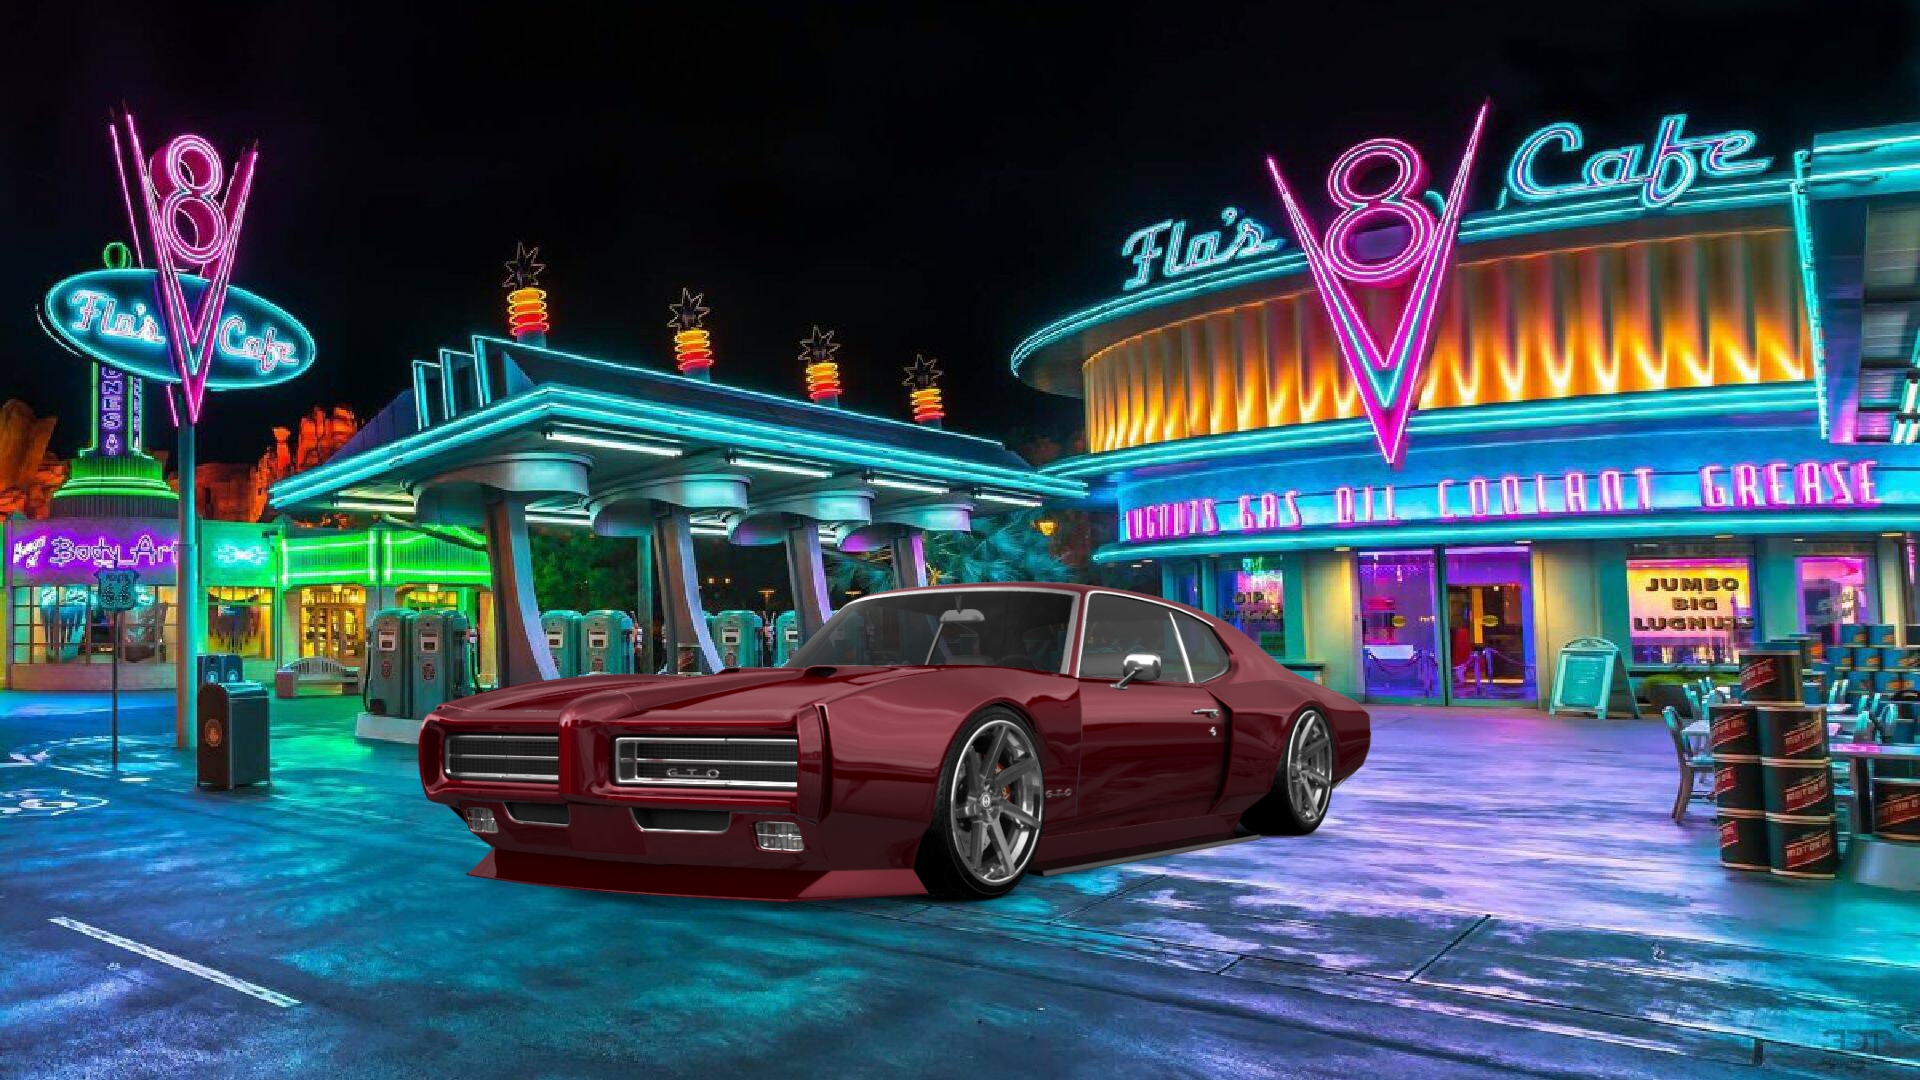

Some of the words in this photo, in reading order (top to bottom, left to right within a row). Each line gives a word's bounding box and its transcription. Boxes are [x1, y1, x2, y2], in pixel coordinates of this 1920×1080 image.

[1122, 206, 1287, 291] Flo's
[1507, 114, 1775, 209] Cafe
[71, 290, 166, 345] Flo's
[219, 315, 300, 374] Cafe
[1238, 489, 1302, 529] GAS
[1335, 485, 1398, 523] OIL
[1438, 467, 1654, 519] COOLANT
[1700, 459, 1882, 508] GREASE
[1645, 577, 1740, 592] JUMBO
[1672, 597, 1718, 611] BIG
[1633, 616, 1755, 632] LUGNUTS
[666, 767, 720, 779] GTO
[1045, 788, 1072, 798] GTO
